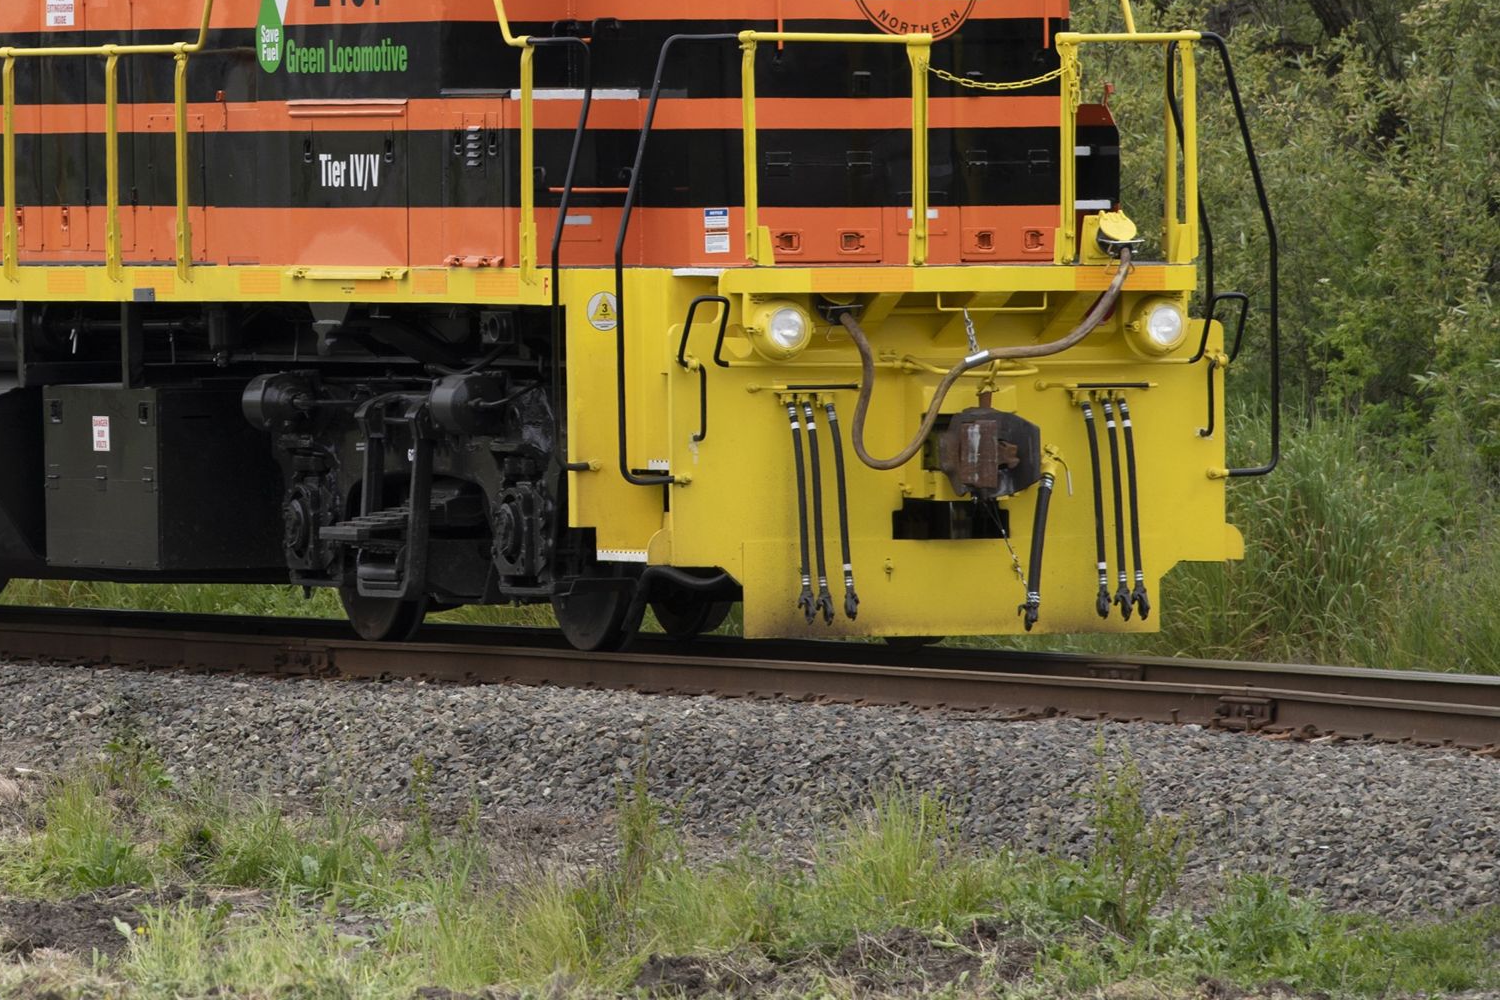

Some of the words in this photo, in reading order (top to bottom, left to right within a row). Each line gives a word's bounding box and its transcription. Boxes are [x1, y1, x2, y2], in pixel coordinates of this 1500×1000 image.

[877, 9, 960, 34] NORTHERN
[260, 25, 279, 43] Save
[262, 43, 279, 62] Fuel
[286, 39, 326, 73] Green
[329, 37, 408, 73] Locomotive
[319, 153, 346, 187] Tier
[349, 153, 380, 191] IV/V
[601, 303, 608, 313] 3
